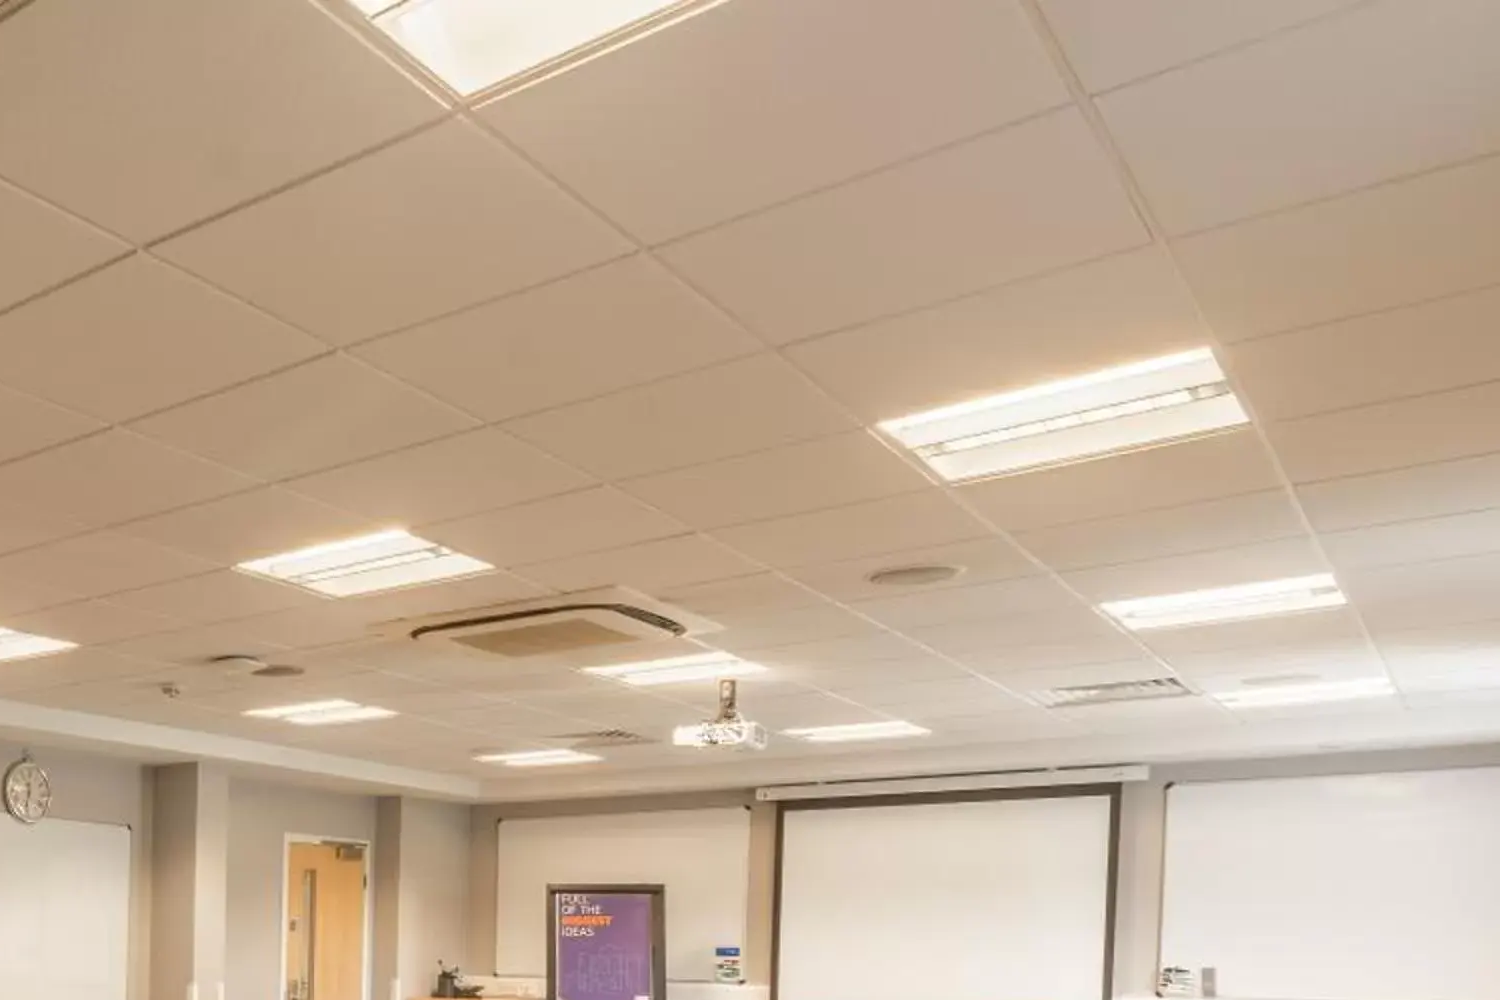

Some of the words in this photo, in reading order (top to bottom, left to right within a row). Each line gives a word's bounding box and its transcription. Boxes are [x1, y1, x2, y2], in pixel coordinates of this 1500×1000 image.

[561, 895, 590, 905] FULL
[561, 905, 576, 915] OF
[580, 905, 602, 915] THE
[561, 927, 595, 937] IDEAS
